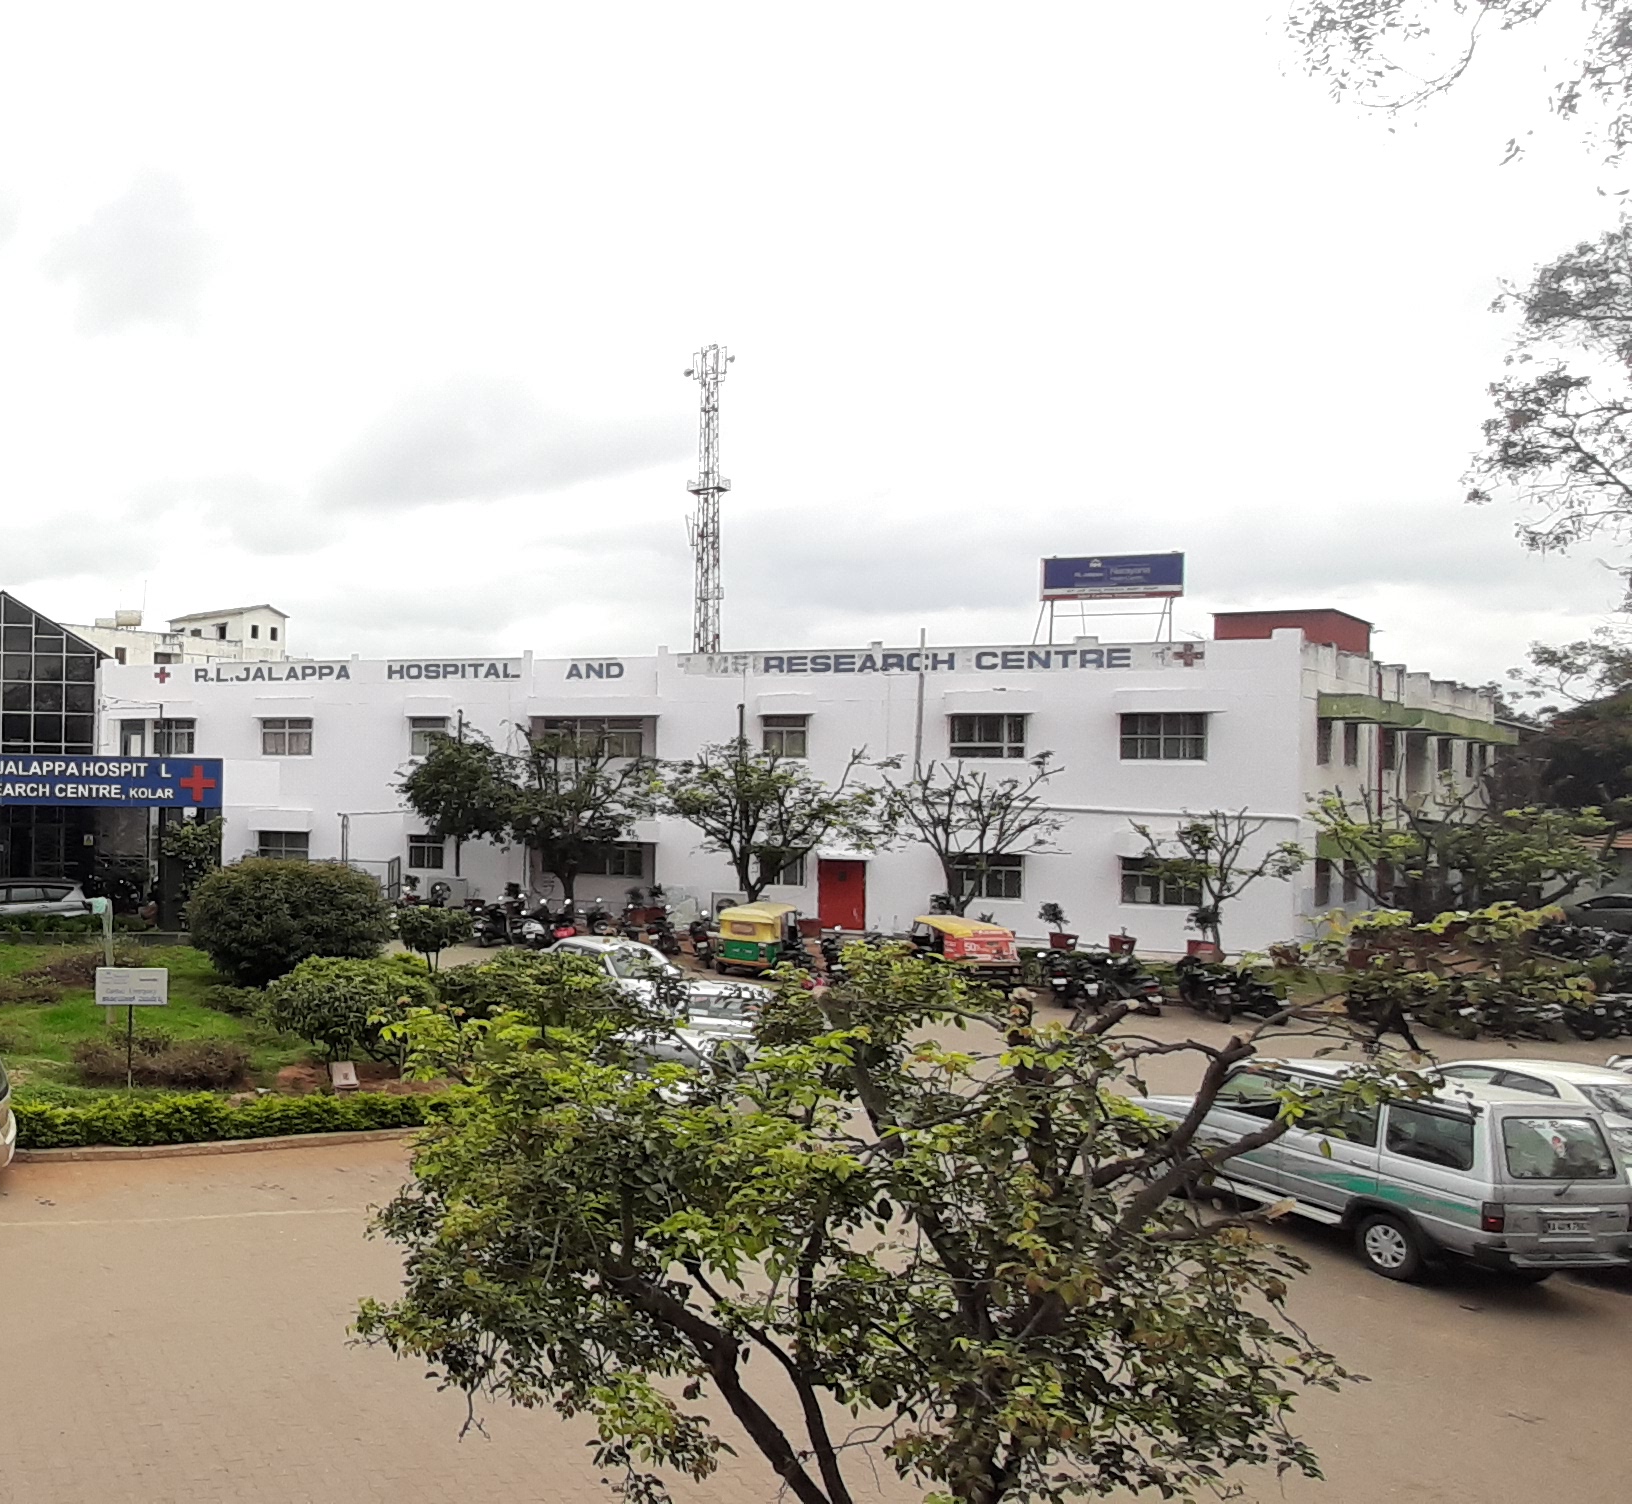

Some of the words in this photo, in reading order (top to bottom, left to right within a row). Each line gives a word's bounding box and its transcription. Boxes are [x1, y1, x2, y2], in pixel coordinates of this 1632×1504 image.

[387, 662, 521, 680] HOSPITAL
[565, 662, 625, 680] AND
[763, 652, 955, 674] RESEARCH
[975, 647, 1132, 670] CENTRE
[82, 761, 172, 778] HOSPITL
[54, 783, 125, 800] CENTRE,
[129, 787, 174, 799] KOLAR
